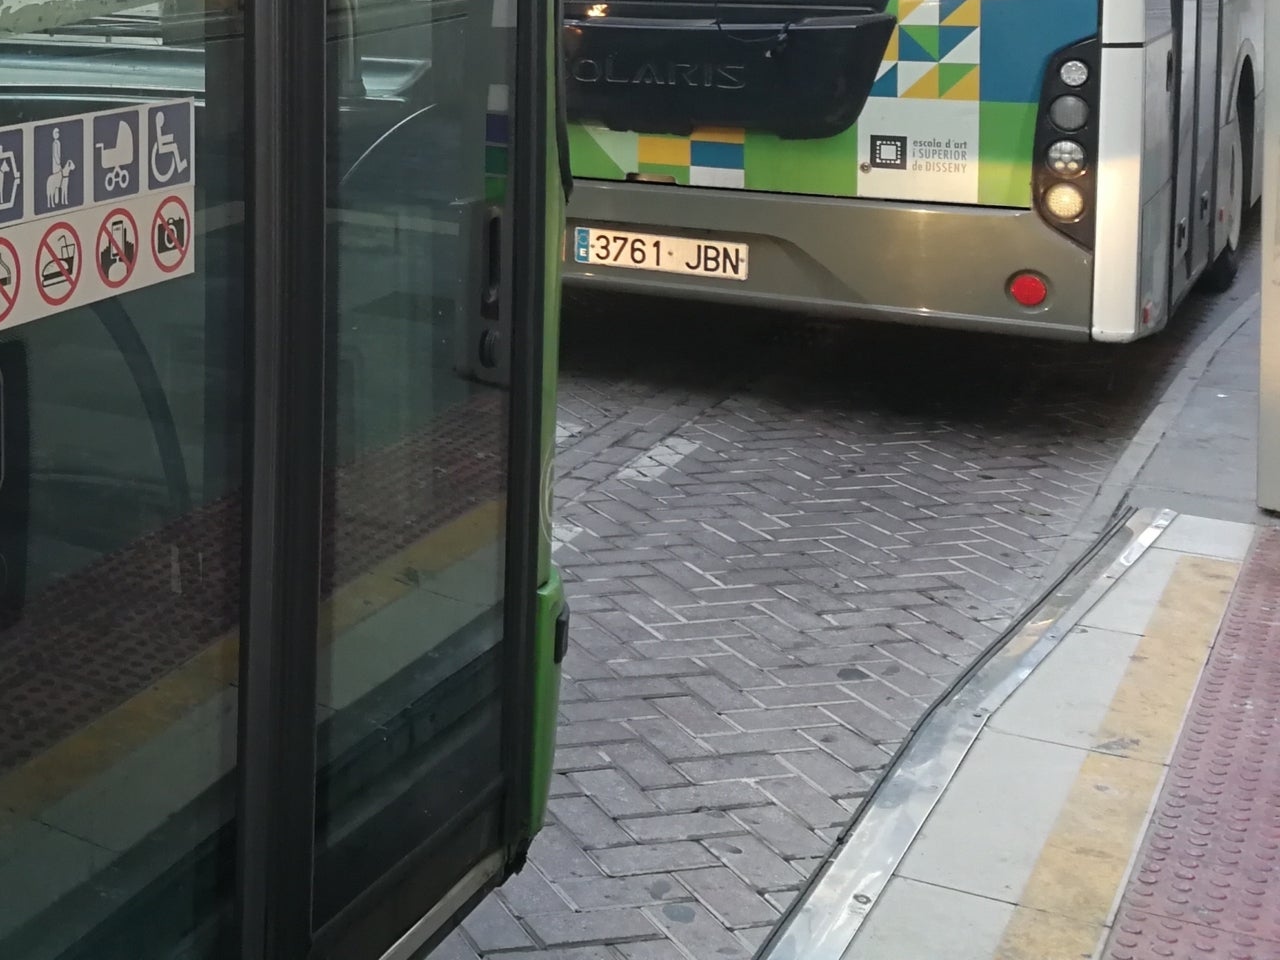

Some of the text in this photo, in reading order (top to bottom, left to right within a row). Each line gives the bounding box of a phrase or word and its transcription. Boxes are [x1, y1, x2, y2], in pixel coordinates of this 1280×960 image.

[564, 58, 746, 89] OLARIS
[913, 138, 942, 149] escola
[918, 148, 968, 161] SUPERIOR
[912, 160, 968, 173] de DISSENY
[579, 247, 587, 257] E
[595, 234, 740, 275] 3761 JBN
